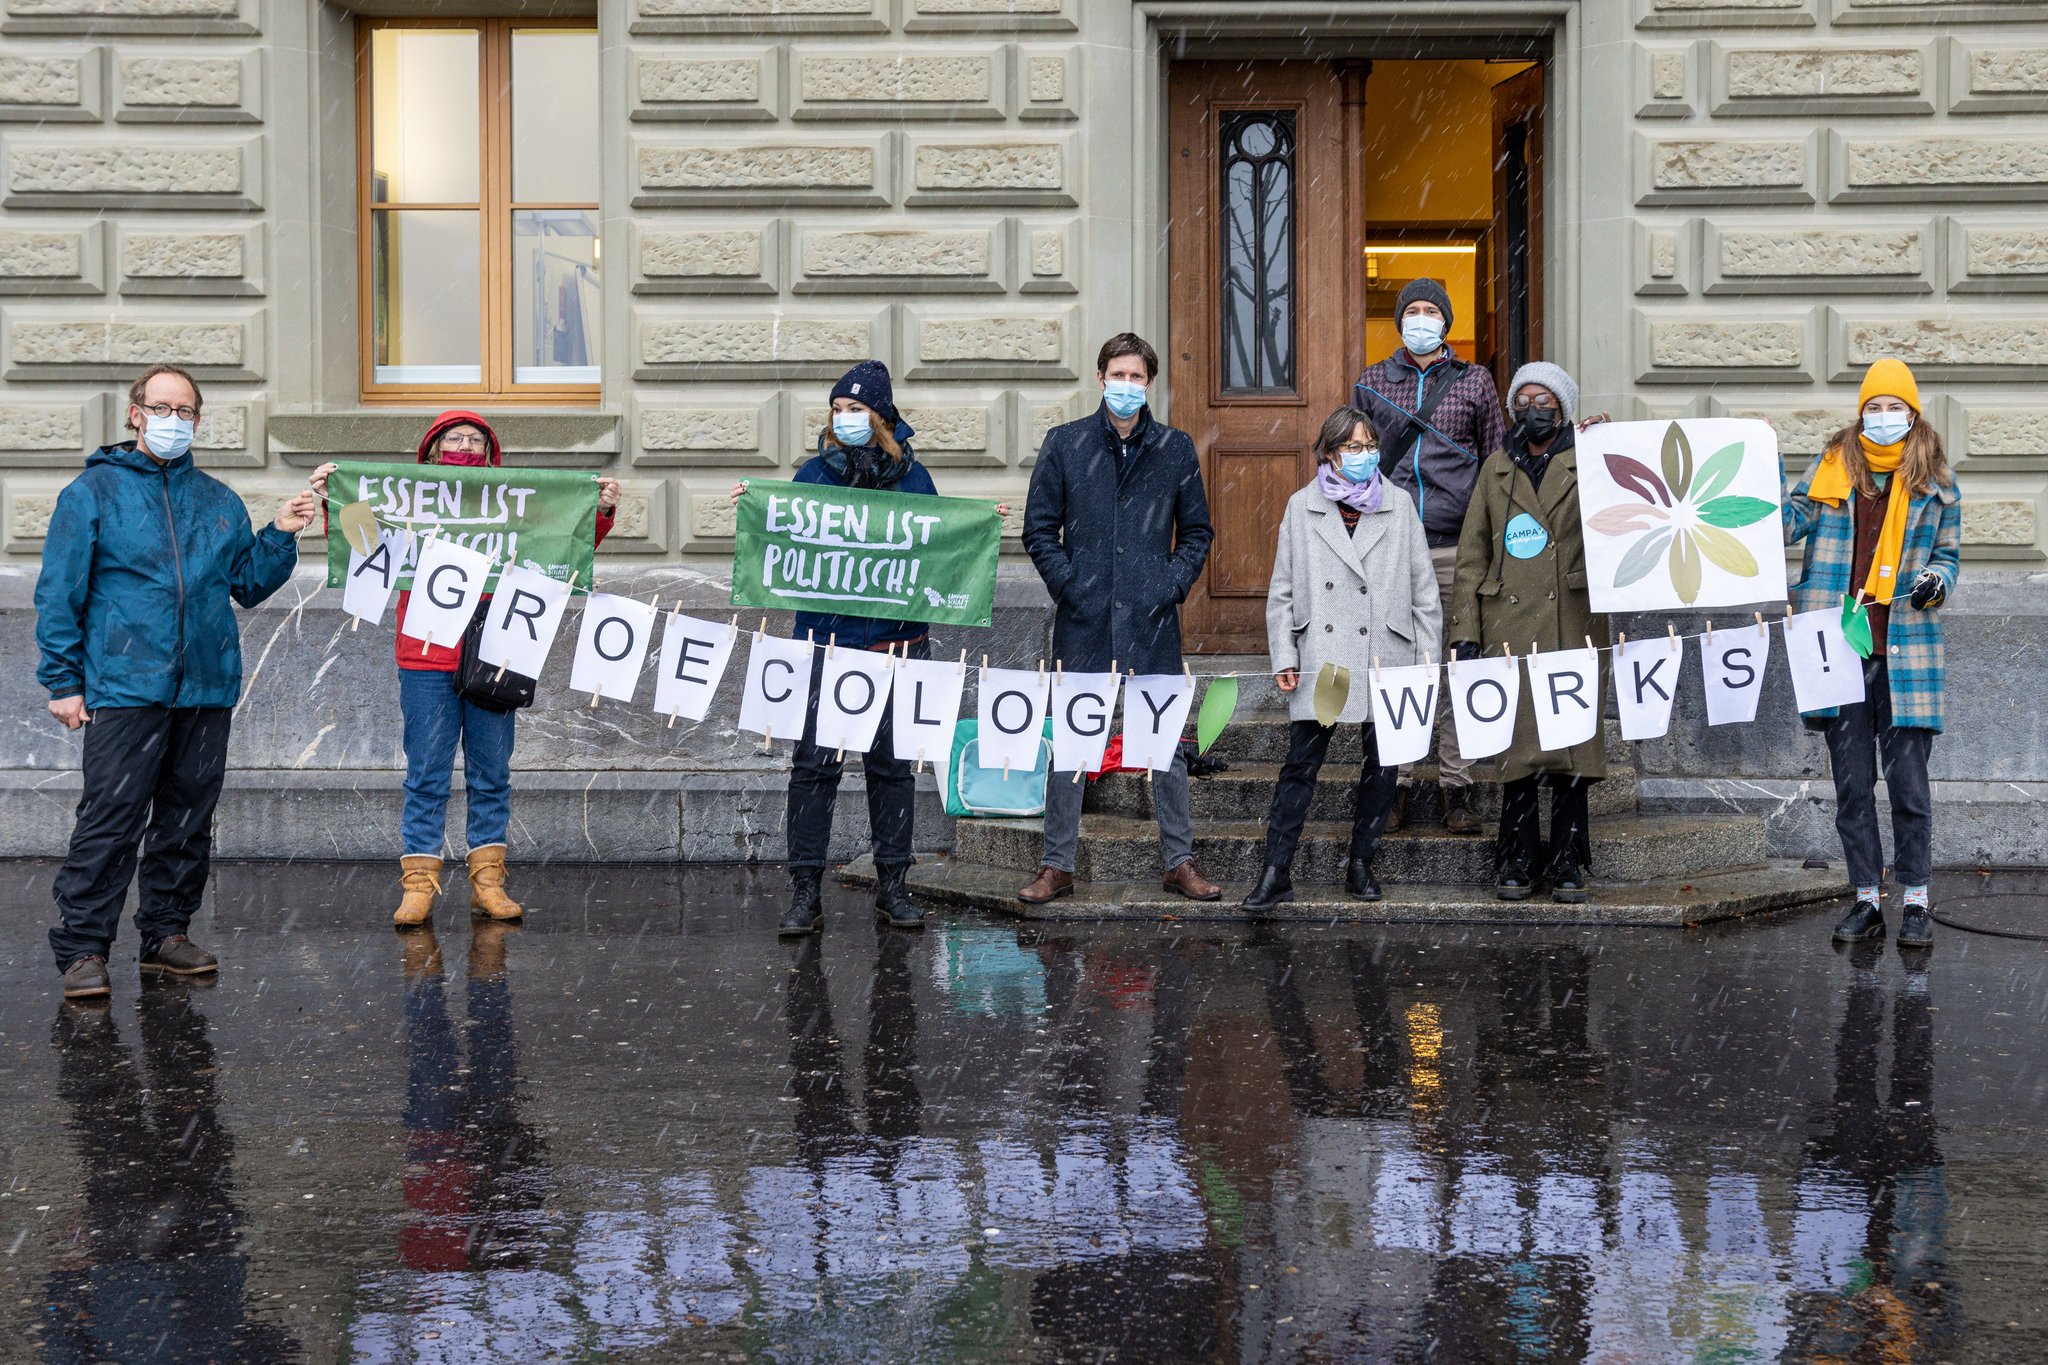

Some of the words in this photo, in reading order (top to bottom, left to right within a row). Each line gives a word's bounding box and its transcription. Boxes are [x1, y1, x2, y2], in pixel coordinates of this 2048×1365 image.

[358, 475, 462, 520] ESSEN
[480, 483, 536, 523] IST
[766, 495, 869, 543] ESSEN
[886, 510, 941, 549] IST
[762, 543, 920, 596] POLITISCH!
